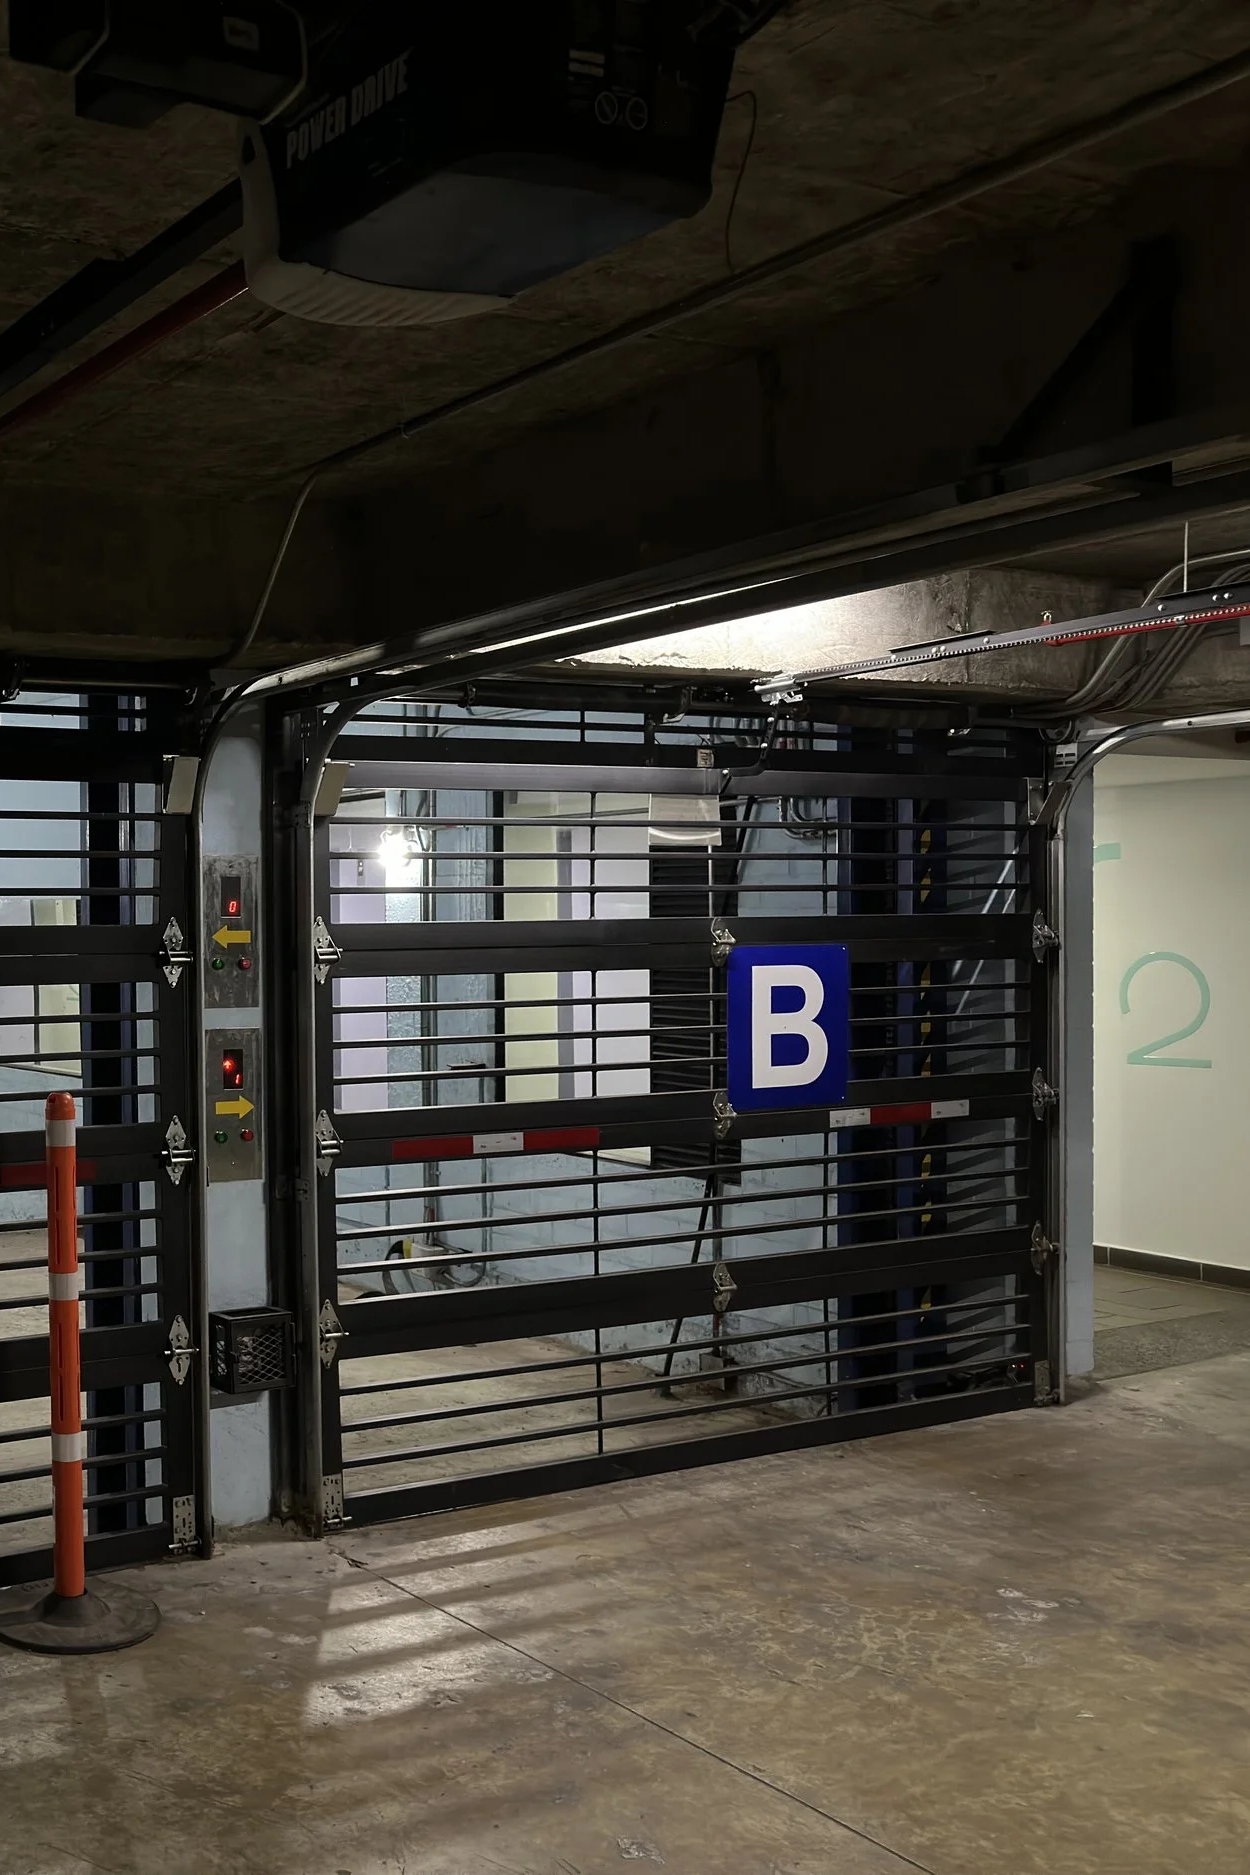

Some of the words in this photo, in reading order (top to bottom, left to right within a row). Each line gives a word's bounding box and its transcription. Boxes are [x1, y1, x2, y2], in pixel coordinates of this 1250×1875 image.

[286, 95, 346, 169] POWER
[350, 52, 410, 127] DRIVE
[228, 901, 237, 913] 0
[752, 965, 828, 1089] B
[1120, 951, 1211, 1067] 2
